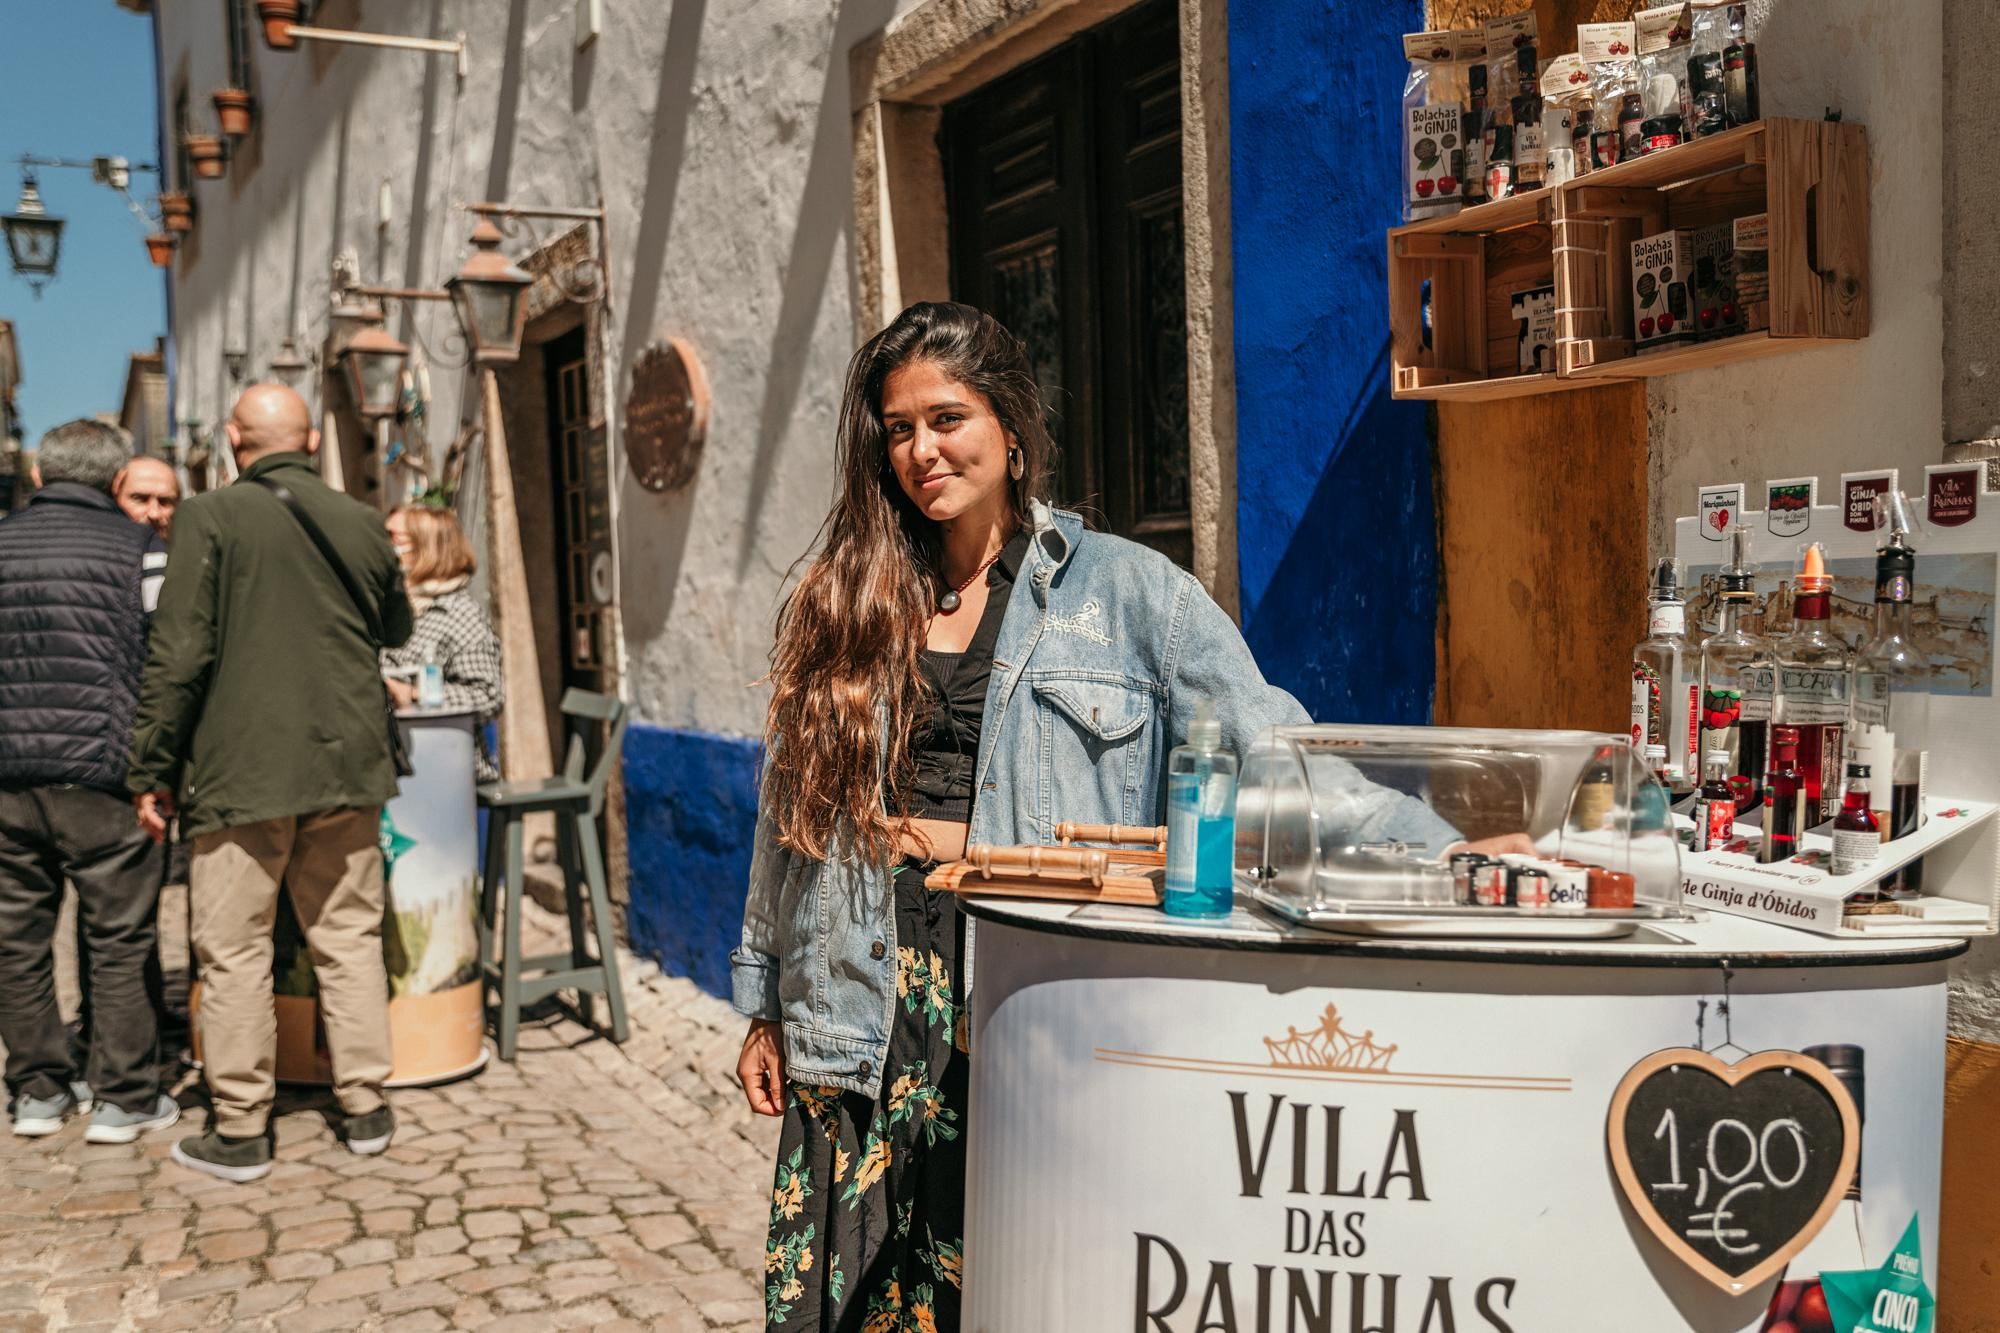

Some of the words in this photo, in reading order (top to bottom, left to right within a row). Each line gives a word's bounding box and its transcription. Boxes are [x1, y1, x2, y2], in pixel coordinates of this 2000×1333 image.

[1412, 108, 1457, 123] Bolachas
[1413, 123, 1423, 132] de
[1425, 119, 1458, 136] GINJA
[1634, 239, 1673, 258] Bolachas
[1635, 258, 1644, 268] de
[1645, 250, 1673, 270] GINJA
[1850, 488, 1876, 500] GINJA
[1701, 882, 1743, 907] Ginja
[1226, 1090, 1432, 1202] VILA
[1652, 1108, 1808, 1207] 1,00
[1284, 1206, 1367, 1259] DAS
[1686, 1181, 1765, 1255] €
[1133, 1231, 1517, 1333] RAINHAS
[1872, 1289, 1919, 1333] CINCO
